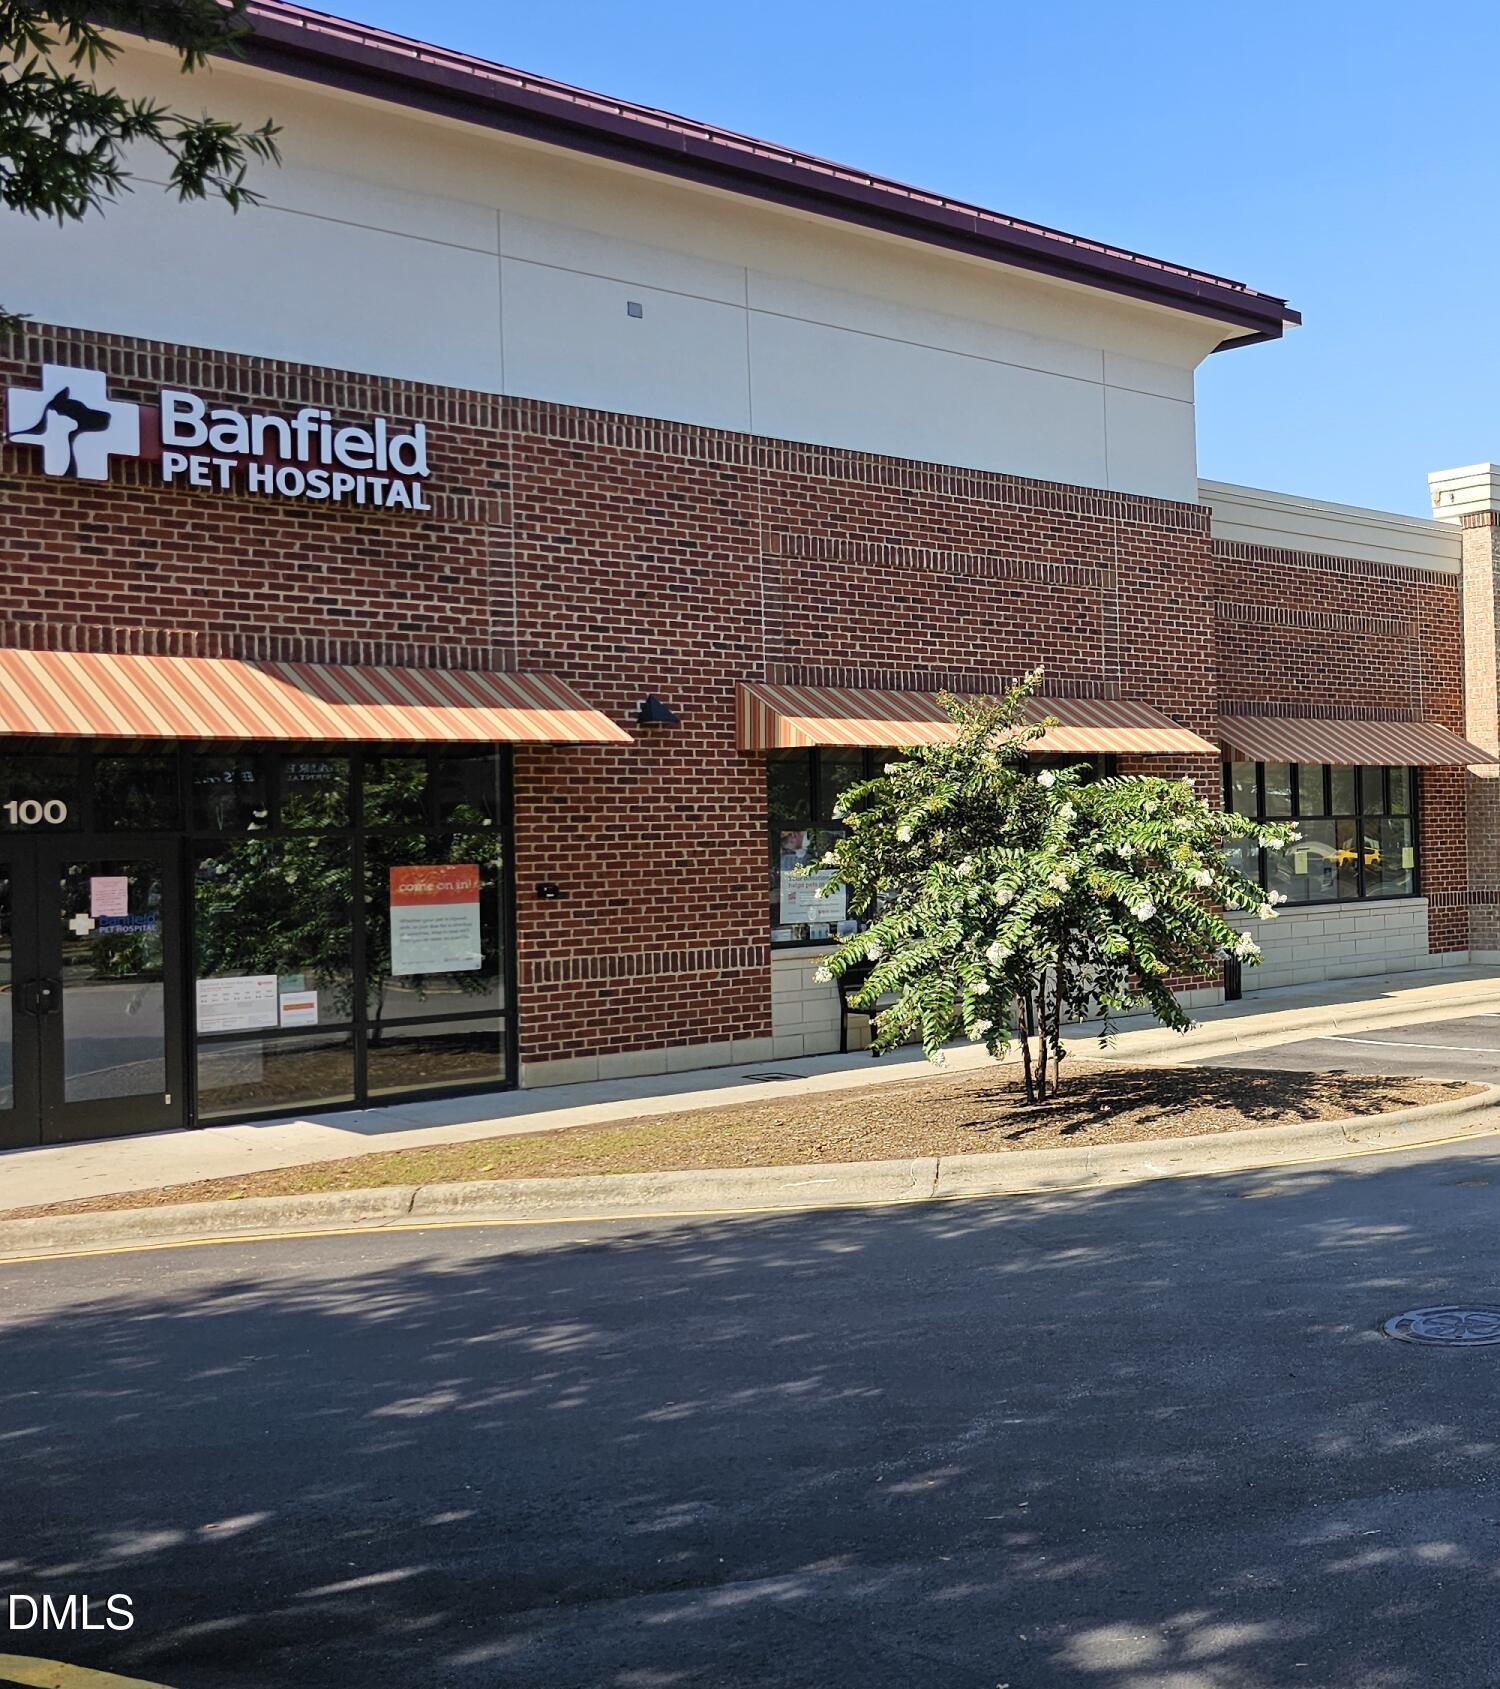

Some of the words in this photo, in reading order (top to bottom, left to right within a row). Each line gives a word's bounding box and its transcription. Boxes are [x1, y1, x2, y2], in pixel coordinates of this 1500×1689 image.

[161, 389, 431, 478] Banfield
[162, 451, 238, 489] PET
[248, 463, 431, 511] HOSPITAL
[3, 799, 67, 825] 100
[399, 882, 433, 892] come
[436, 881, 454, 890] on
